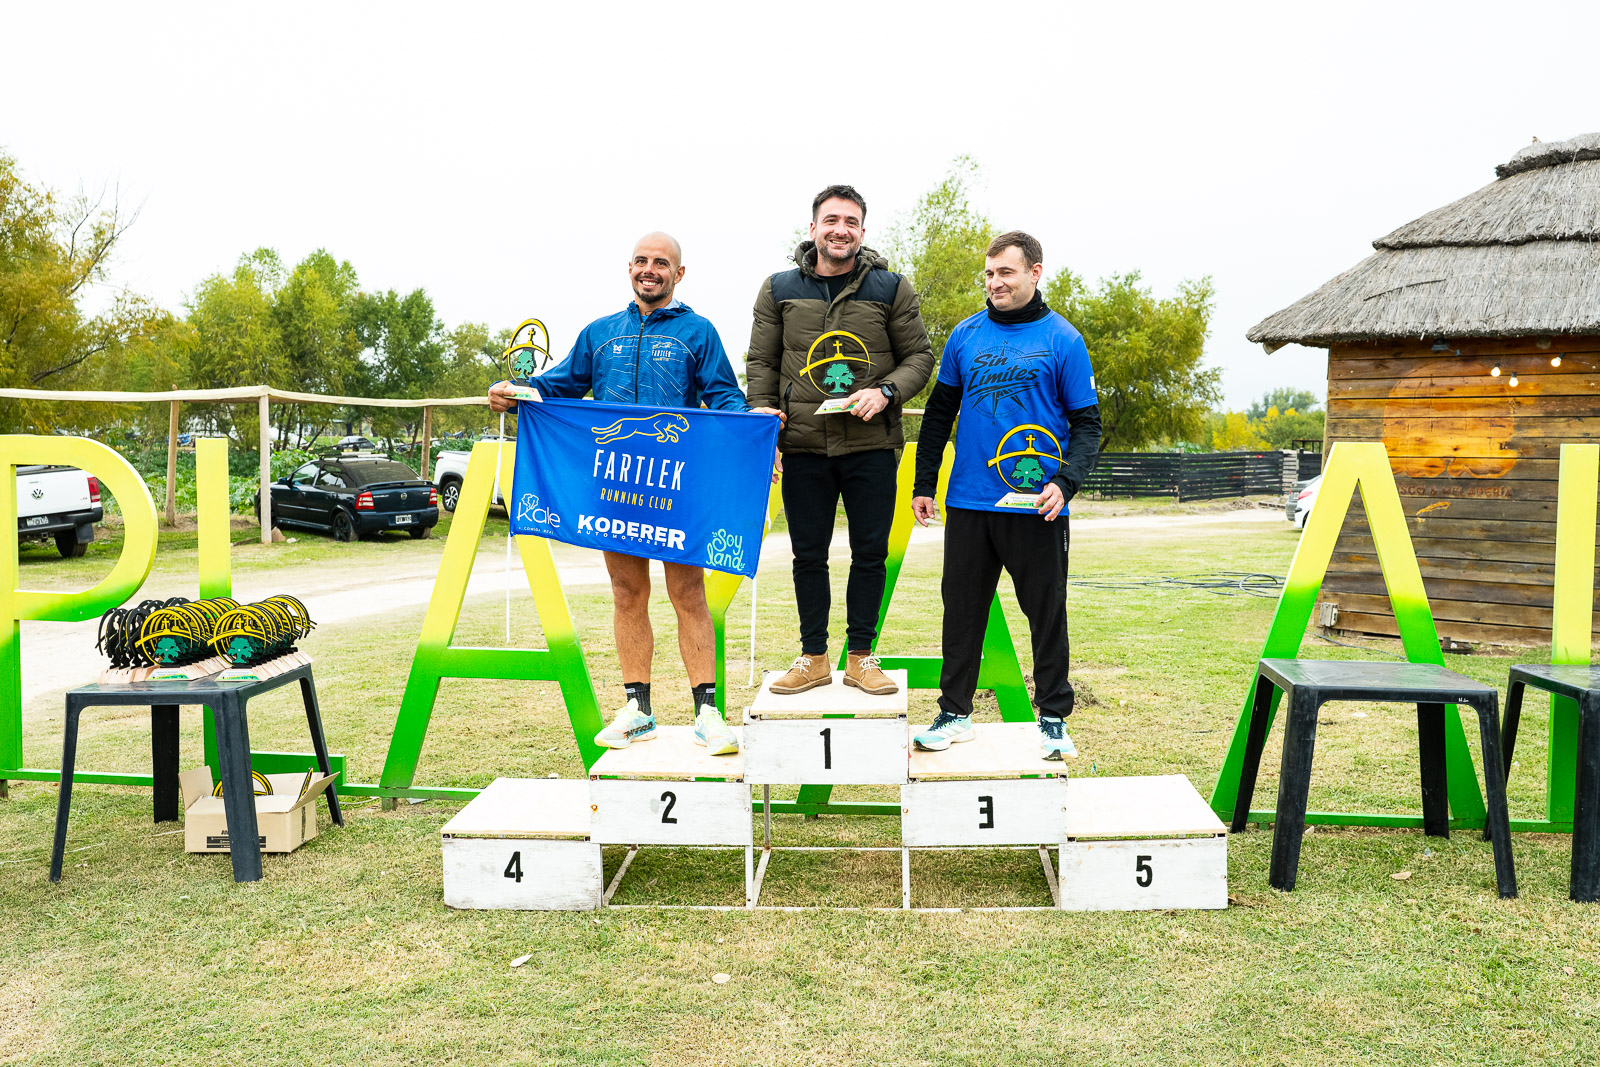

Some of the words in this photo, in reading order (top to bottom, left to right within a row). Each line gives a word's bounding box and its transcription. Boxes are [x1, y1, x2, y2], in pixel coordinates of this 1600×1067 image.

[969, 354, 1009, 371] Sin
[593, 448, 686, 491] FARTLEK
[600, 487, 644, 507] RUNNING
[649, 496, 673, 511] CLUB
[517, 501, 561, 528] Kale
[576, 529, 666, 547] AUTOMOTORES
[577, 514, 686, 550] KODERER
[712, 528, 743, 556] Soy
[705, 542, 744, 571] land
[819, 727, 832, 770] 1
[660, 791, 678, 824] 2
[503, 851, 524, 883] 4
[1135, 855, 1153, 888] 5
